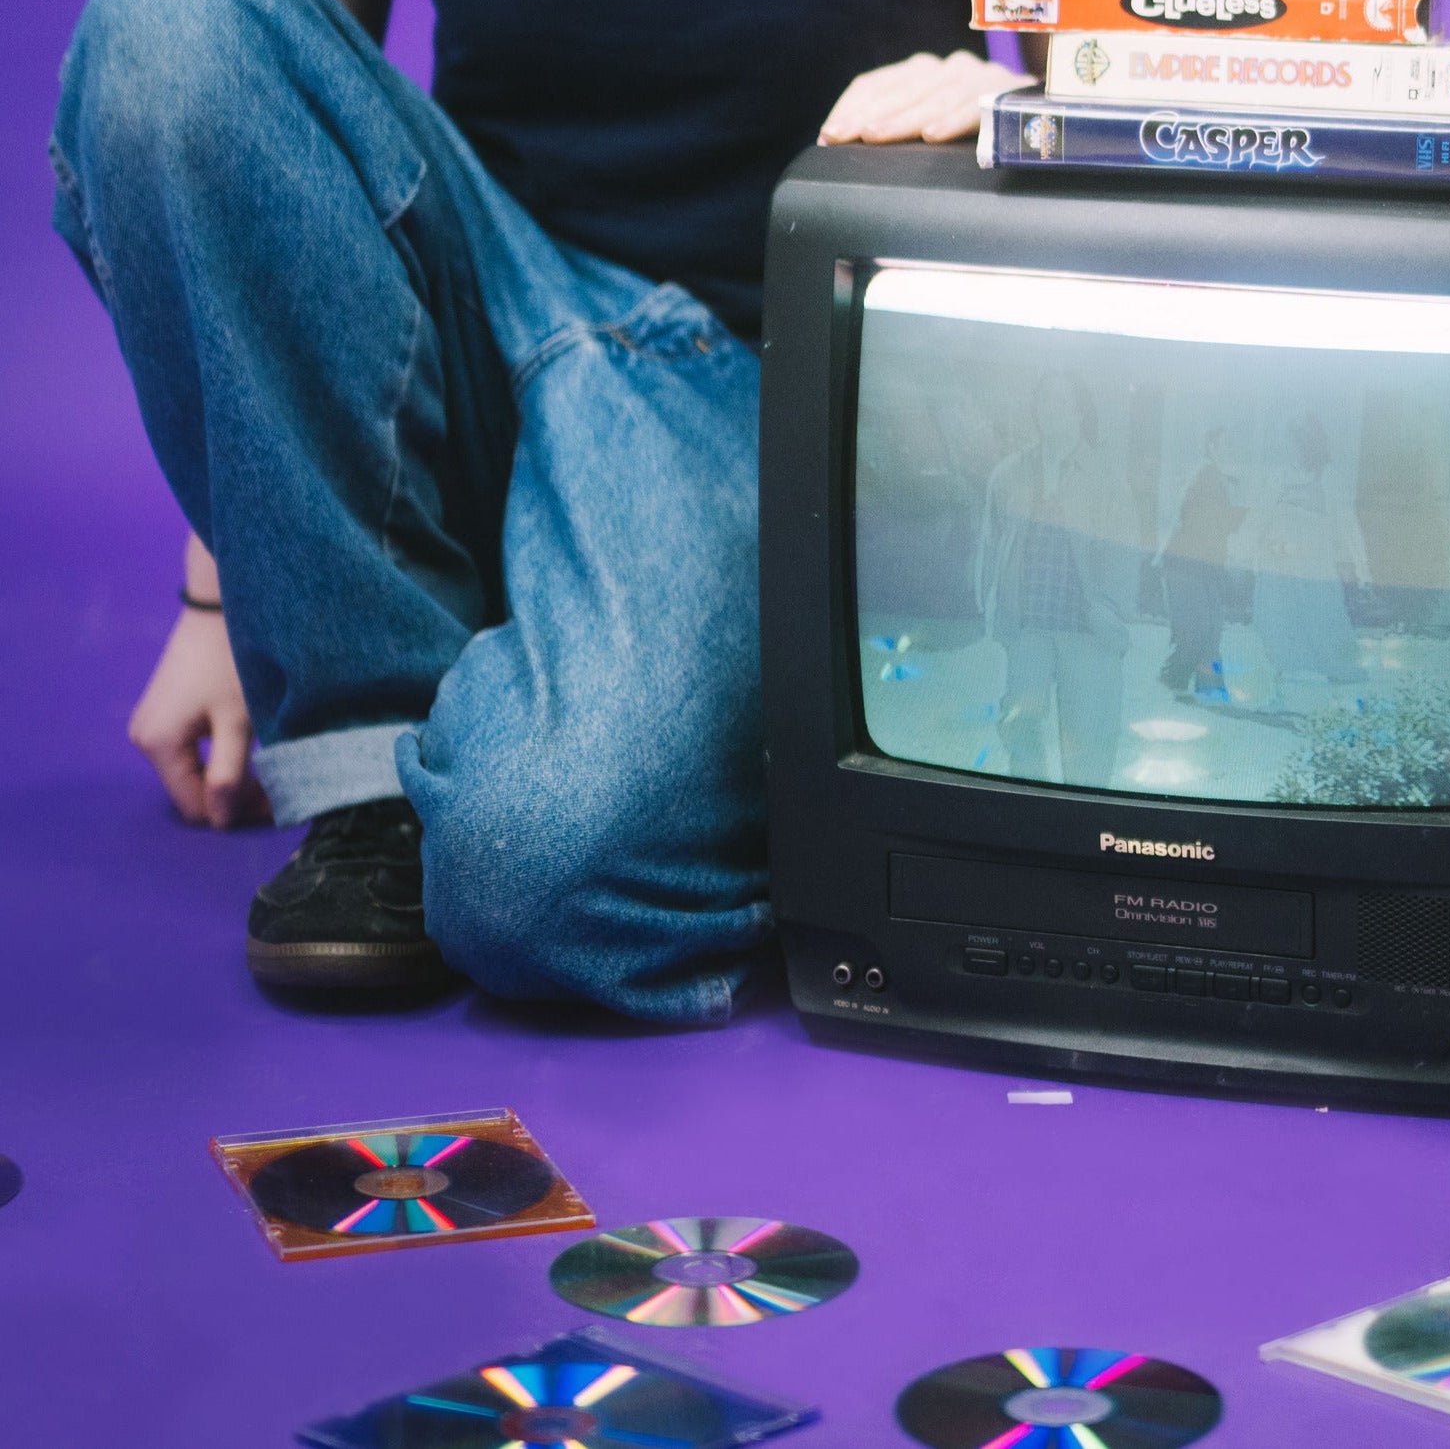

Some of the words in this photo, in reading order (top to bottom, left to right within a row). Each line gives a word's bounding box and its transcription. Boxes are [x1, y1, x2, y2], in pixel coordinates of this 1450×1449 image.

[1129, 51, 1221, 82] EMPIRE
[1227, 55, 1353, 88] RECORDS
[1139, 110, 1326, 172] CASPER
[1417, 137, 1434, 170] VHS
[1099, 832, 1216, 860] Panasonic
[1114, 894, 1144, 906] FM
[1150, 898, 1218, 914] RADIO
[1114, 908, 1192, 926] Omnivision
[967, 934, 999, 945] POWER
[1029, 941, 1046, 950] VOL
[1086, 946, 1100, 955] CH
